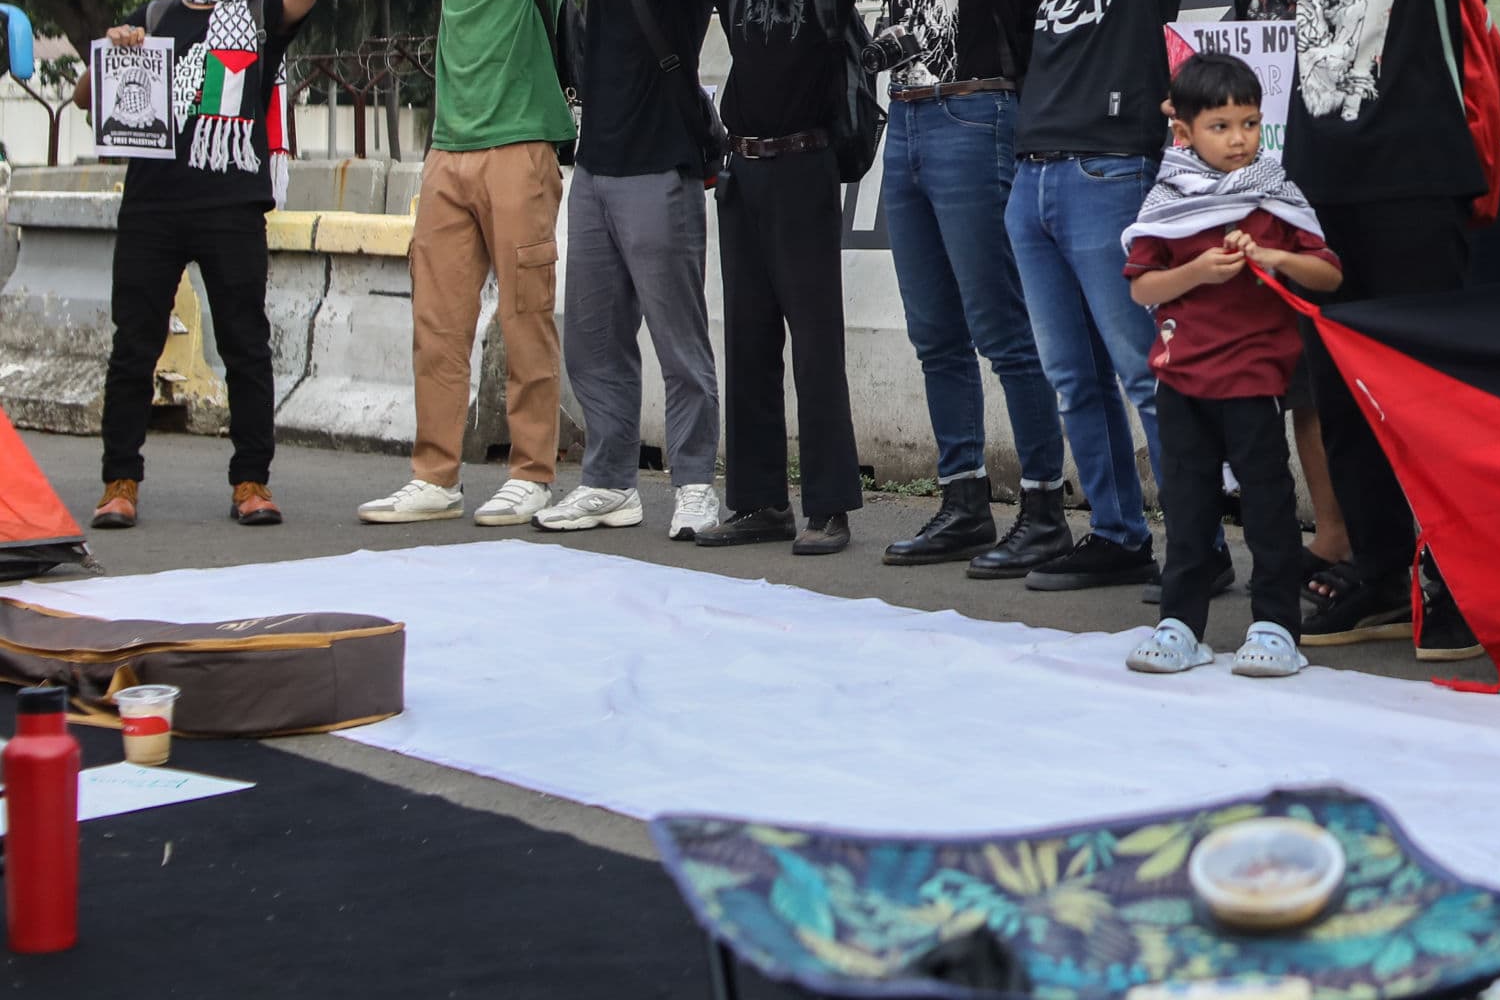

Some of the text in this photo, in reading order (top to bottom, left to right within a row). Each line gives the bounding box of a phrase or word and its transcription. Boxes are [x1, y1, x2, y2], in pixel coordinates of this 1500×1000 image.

[1194, 28, 1231, 55] THIS
[1235, 26, 1252, 54] IS
[105, 56, 163, 75] FUCK OFF
[179, 56, 203, 67] we
